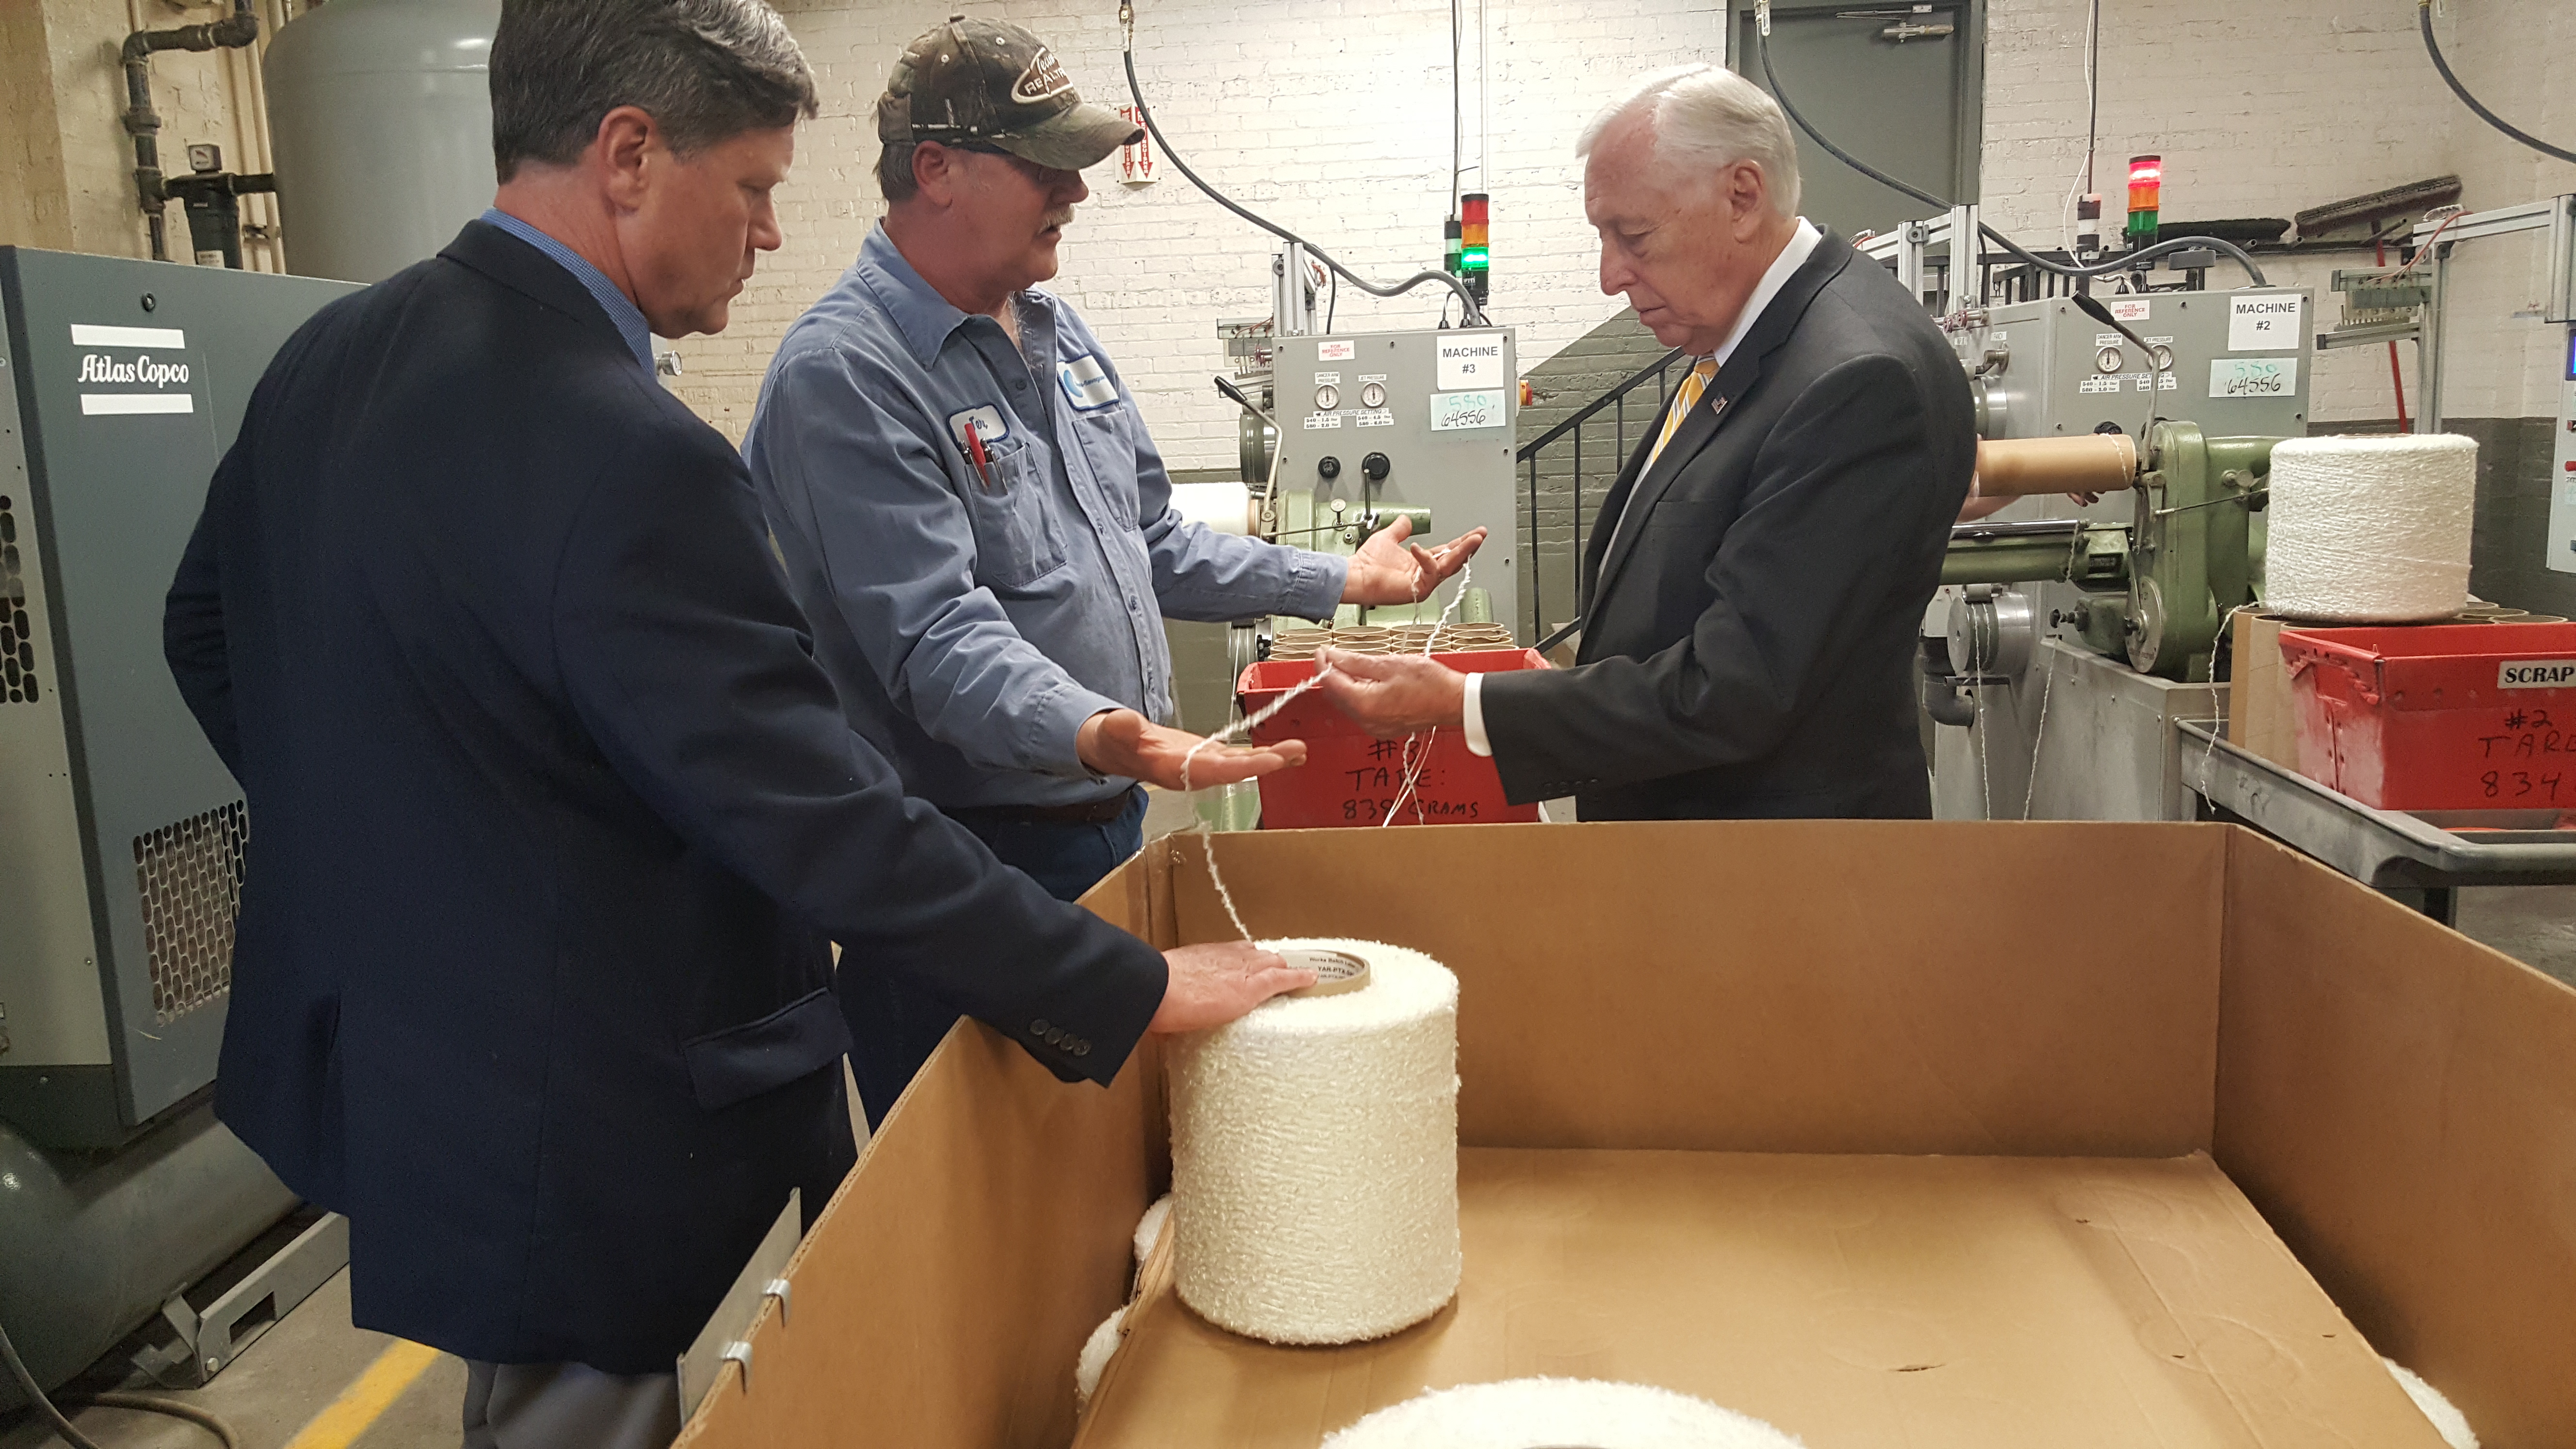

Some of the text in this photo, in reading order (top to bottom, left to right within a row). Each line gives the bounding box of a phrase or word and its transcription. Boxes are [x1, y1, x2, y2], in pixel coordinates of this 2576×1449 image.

[2236, 302, 2296, 314] MACHINE
[2256, 321, 2270, 331] #2
[1443, 346, 1498, 357] MACHINE
[77, 354, 189, 388] Atlas Copco
[1462, 364, 1476, 373] #3
[2504, 667, 2574, 683] SCRAP
[2505, 708, 2552, 730] #2
[1408, 799, 1478, 818] GRAMS
